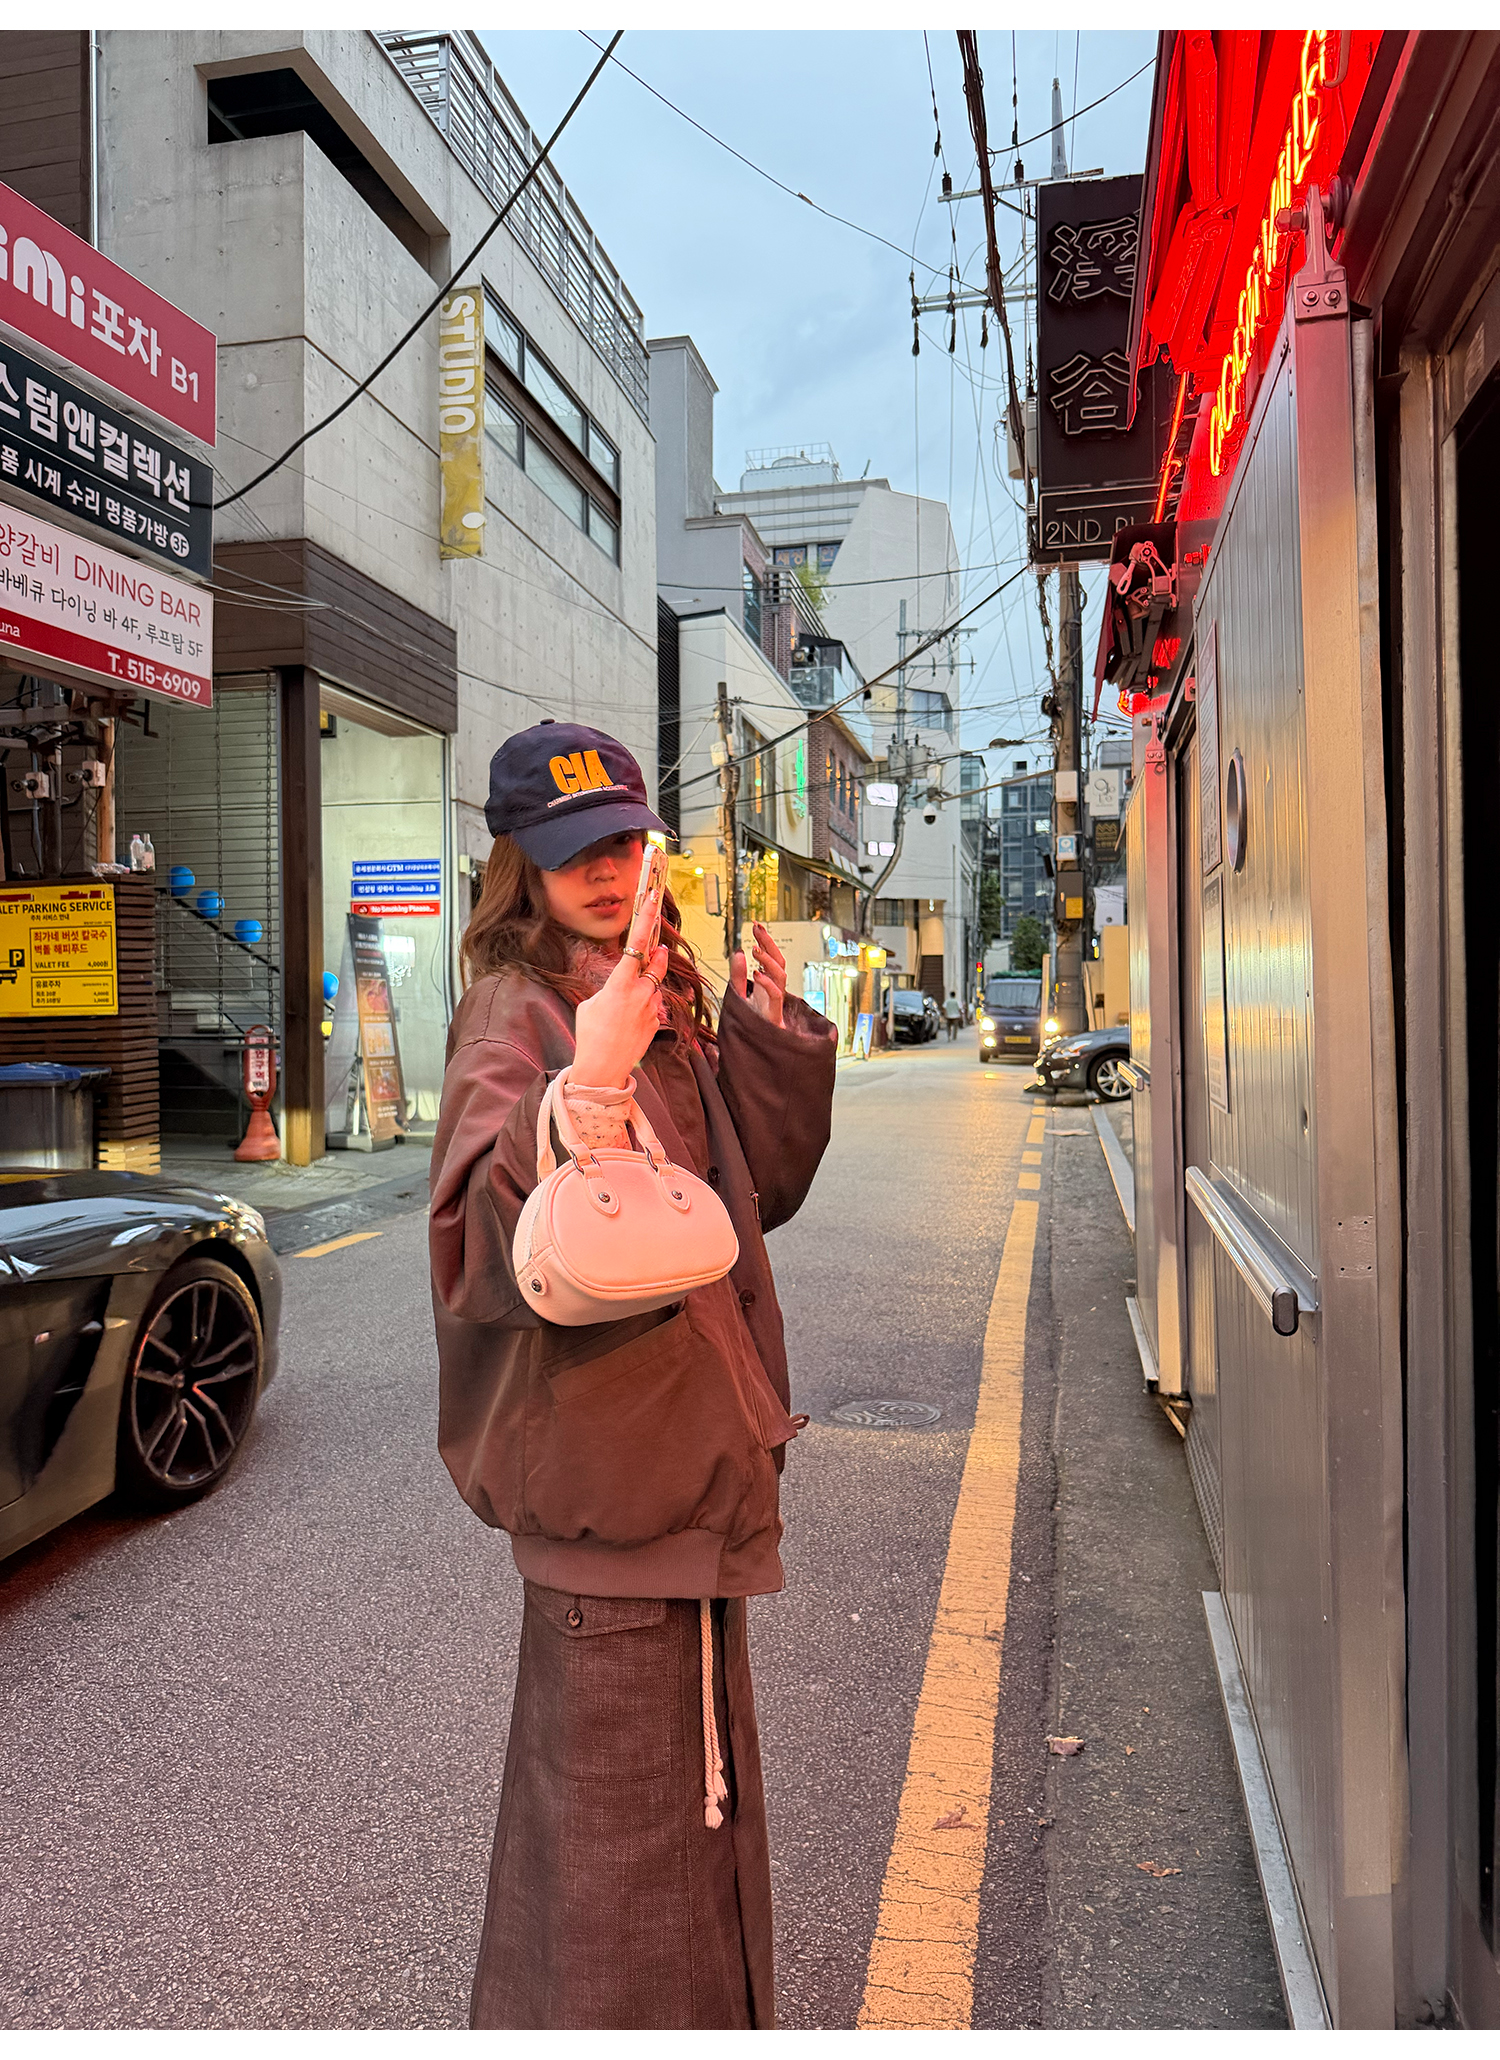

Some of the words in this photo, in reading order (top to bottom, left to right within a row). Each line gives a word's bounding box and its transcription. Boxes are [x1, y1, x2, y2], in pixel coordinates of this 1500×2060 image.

[171, 357, 198, 402] B1
[440, 294, 476, 435] STUDIO
[24, 458, 61, 497] 시계
[66, 479, 101, 516] 수리
[105, 497, 169, 549] 명품가방
[172, 535, 190, 555] 3F
[1045, 518, 1102, 545] 2ND
[0, 567, 45, 603] 바베큐
[51, 588, 97, 623] 다이닝
[103, 607, 118, 630] 바
[121, 615, 142, 641] 4F,
[145, 623, 184, 654] 루프탑
[187, 640, 203, 657] 5F
[74, 554, 155, 607] DINING
[160, 590, 202, 627] BAR
[107, 651, 124, 675] T.
[127, 658, 202, 699] 515-6909
[548, 749, 614, 794] CIA
[0, 904, 20, 915] LET
[22, 902, 67, 914] PARKING
[69, 901, 113, 912] SERVICE
[12, 950, 23, 966] P
[35, 961, 57, 969] VALET
